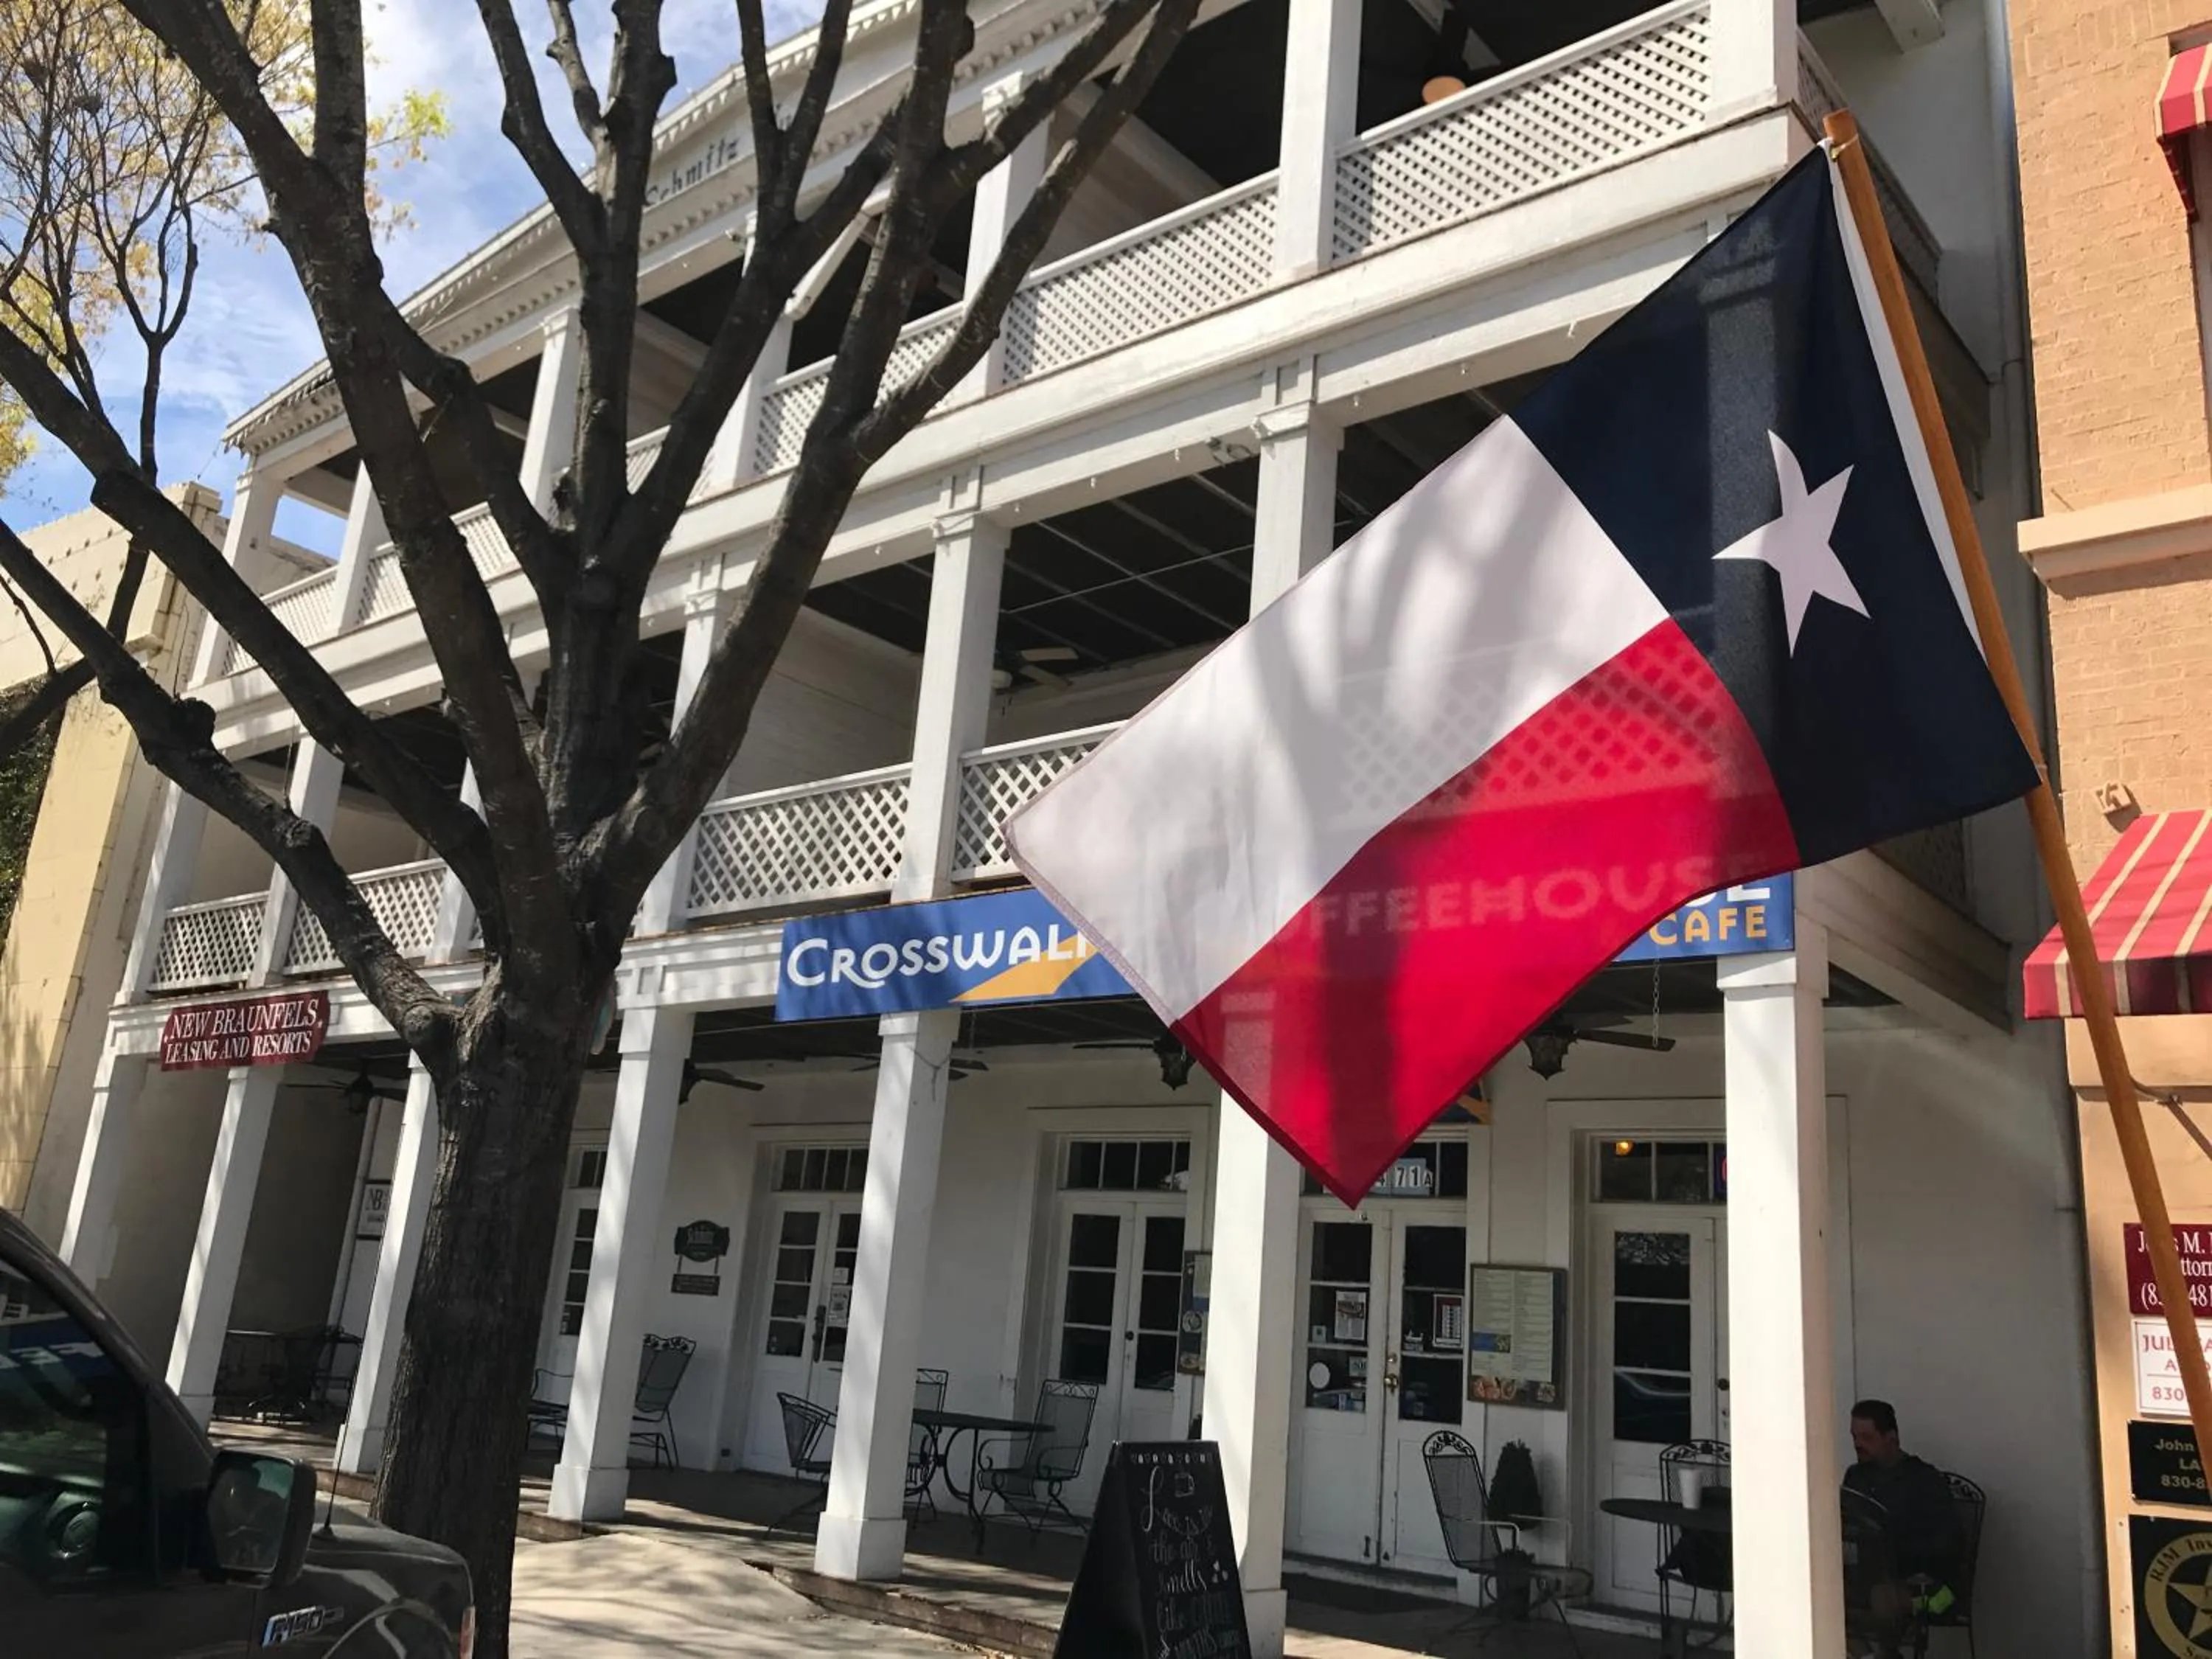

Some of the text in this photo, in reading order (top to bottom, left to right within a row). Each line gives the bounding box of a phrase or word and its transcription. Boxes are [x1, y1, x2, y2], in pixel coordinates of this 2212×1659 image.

[1649, 905, 1767, 947] CAFE
[170, 999, 319, 1039] NEW BRAUNFELS
[165, 1031, 313, 1064] LEASING AND RESORTS
[2154, 1439, 2194, 1451] John
[2179, 1458, 2202, 1472] LA
